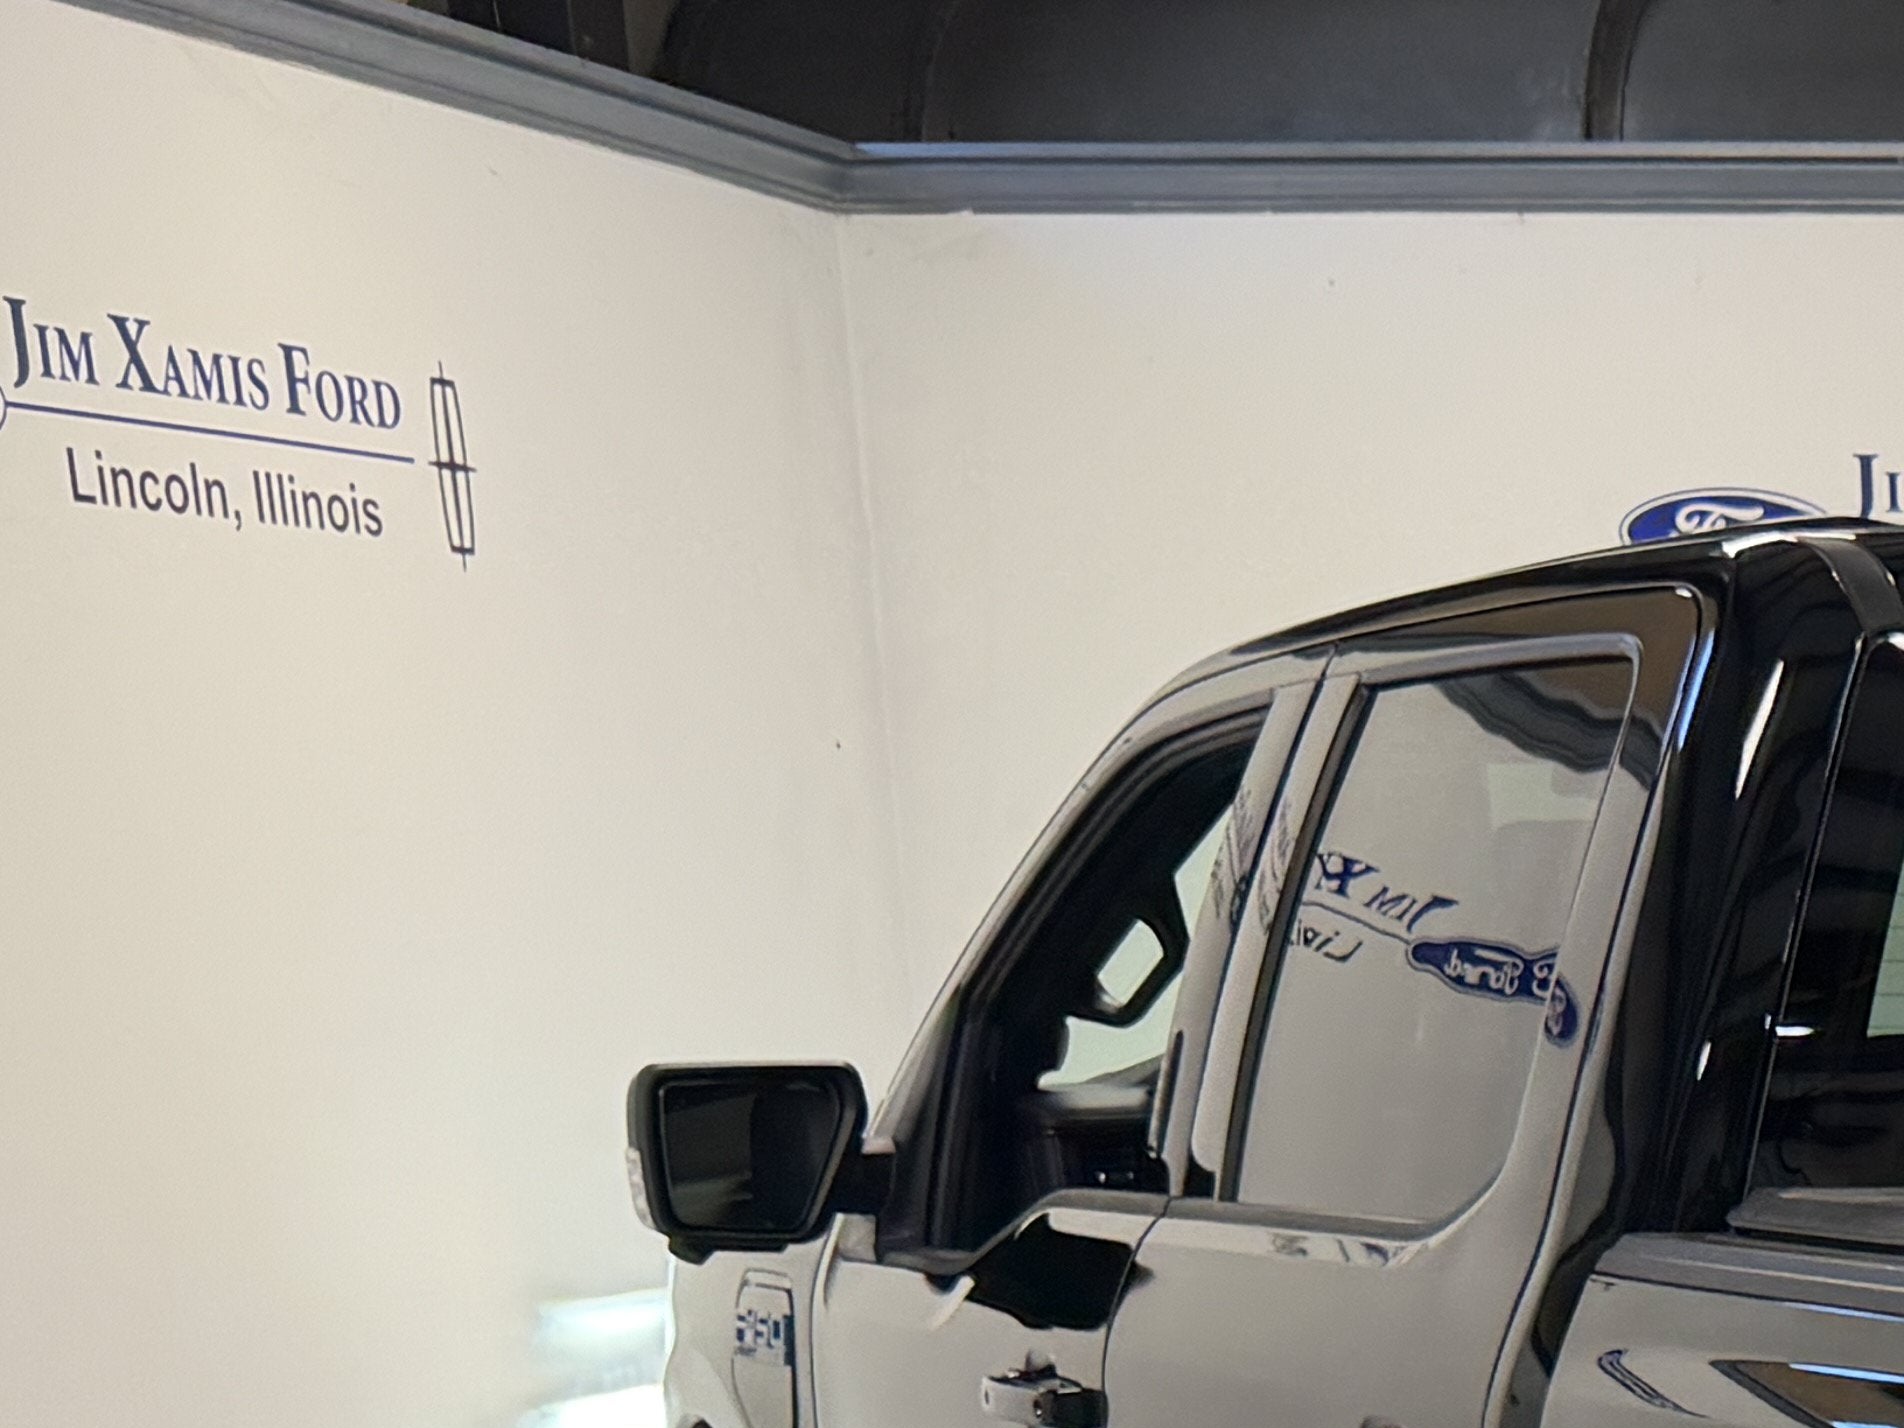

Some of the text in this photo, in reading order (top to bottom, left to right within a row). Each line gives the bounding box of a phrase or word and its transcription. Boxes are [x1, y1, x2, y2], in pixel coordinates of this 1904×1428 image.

[2, 296, 402, 430] JIM XAMIS FORD
[66, 446, 384, 538] Lincoln, Illinois
